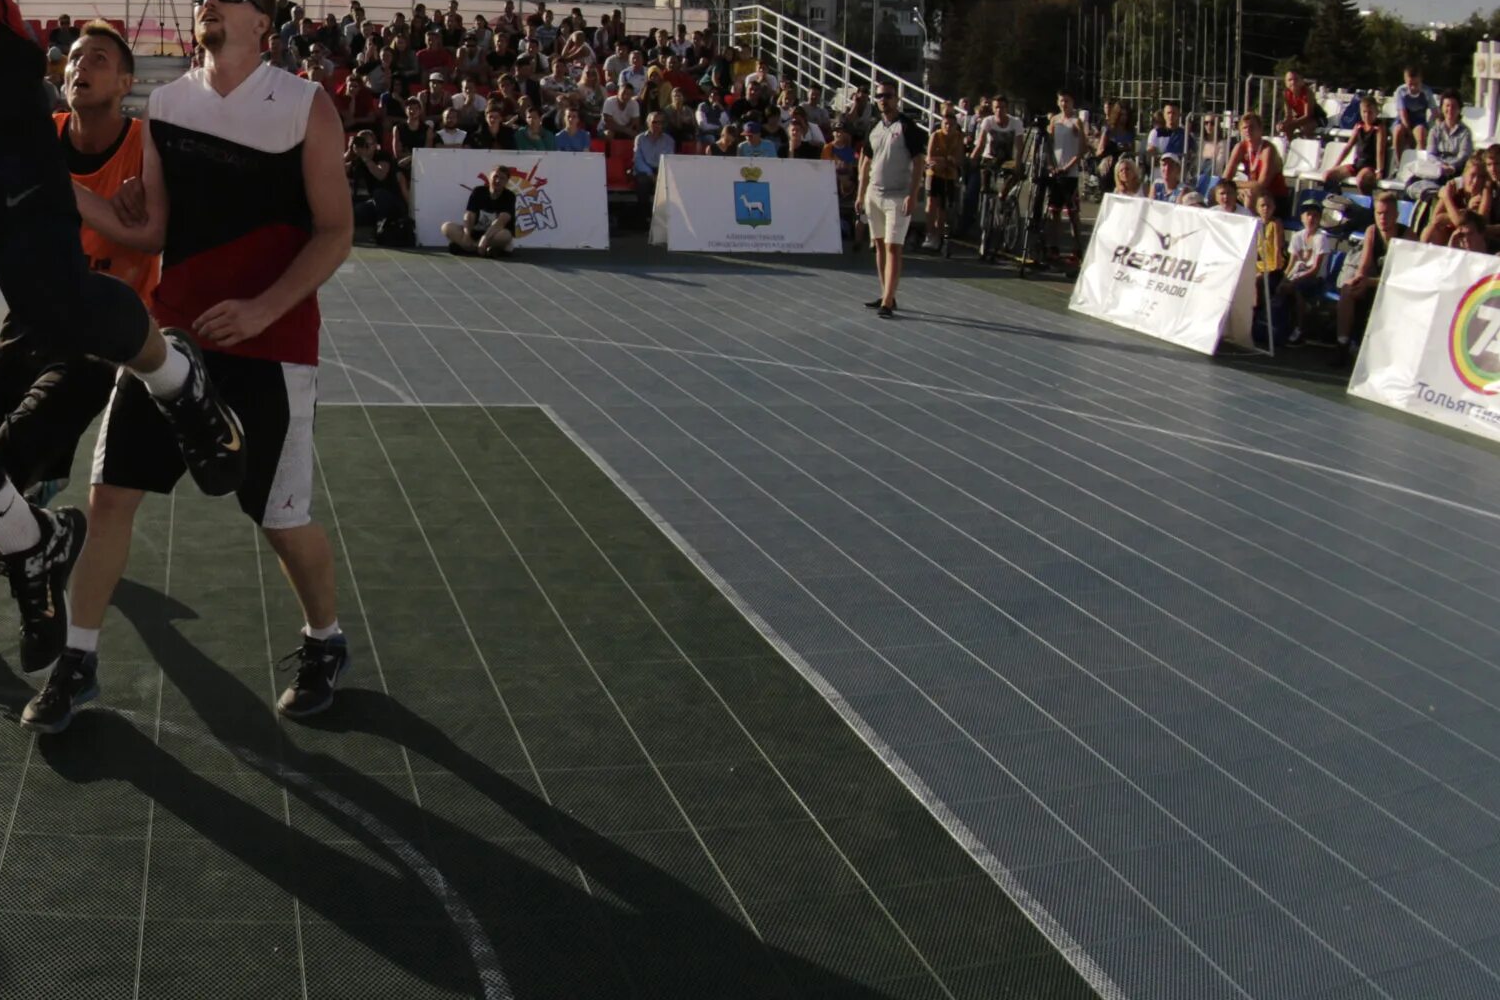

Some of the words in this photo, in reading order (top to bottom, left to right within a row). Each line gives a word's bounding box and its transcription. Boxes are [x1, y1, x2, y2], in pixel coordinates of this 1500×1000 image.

[515, 205, 558, 231] EN
[1113, 270, 1155, 290] DAE
[1154, 281, 1188, 298] RADIO
